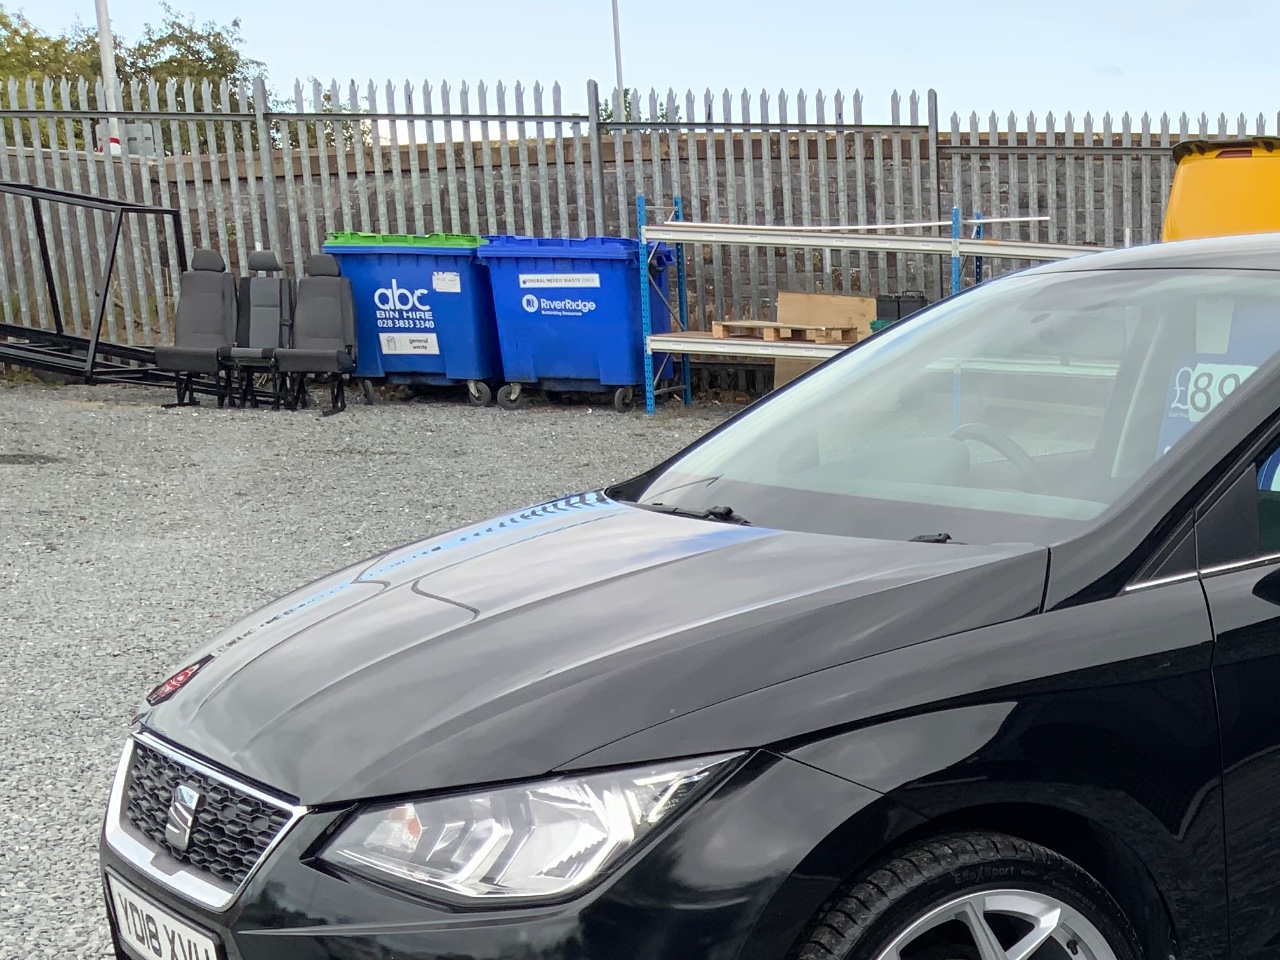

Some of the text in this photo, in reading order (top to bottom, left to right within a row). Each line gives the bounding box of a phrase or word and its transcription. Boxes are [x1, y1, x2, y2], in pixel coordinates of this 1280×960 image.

[374, 278, 431, 311] abc
[540, 298, 597, 313] RiverRidge
[376, 310, 434, 319] BIN HIRE
[377, 319, 435, 328] 028 3833 3340
[118, 892, 163, 959] YD18
